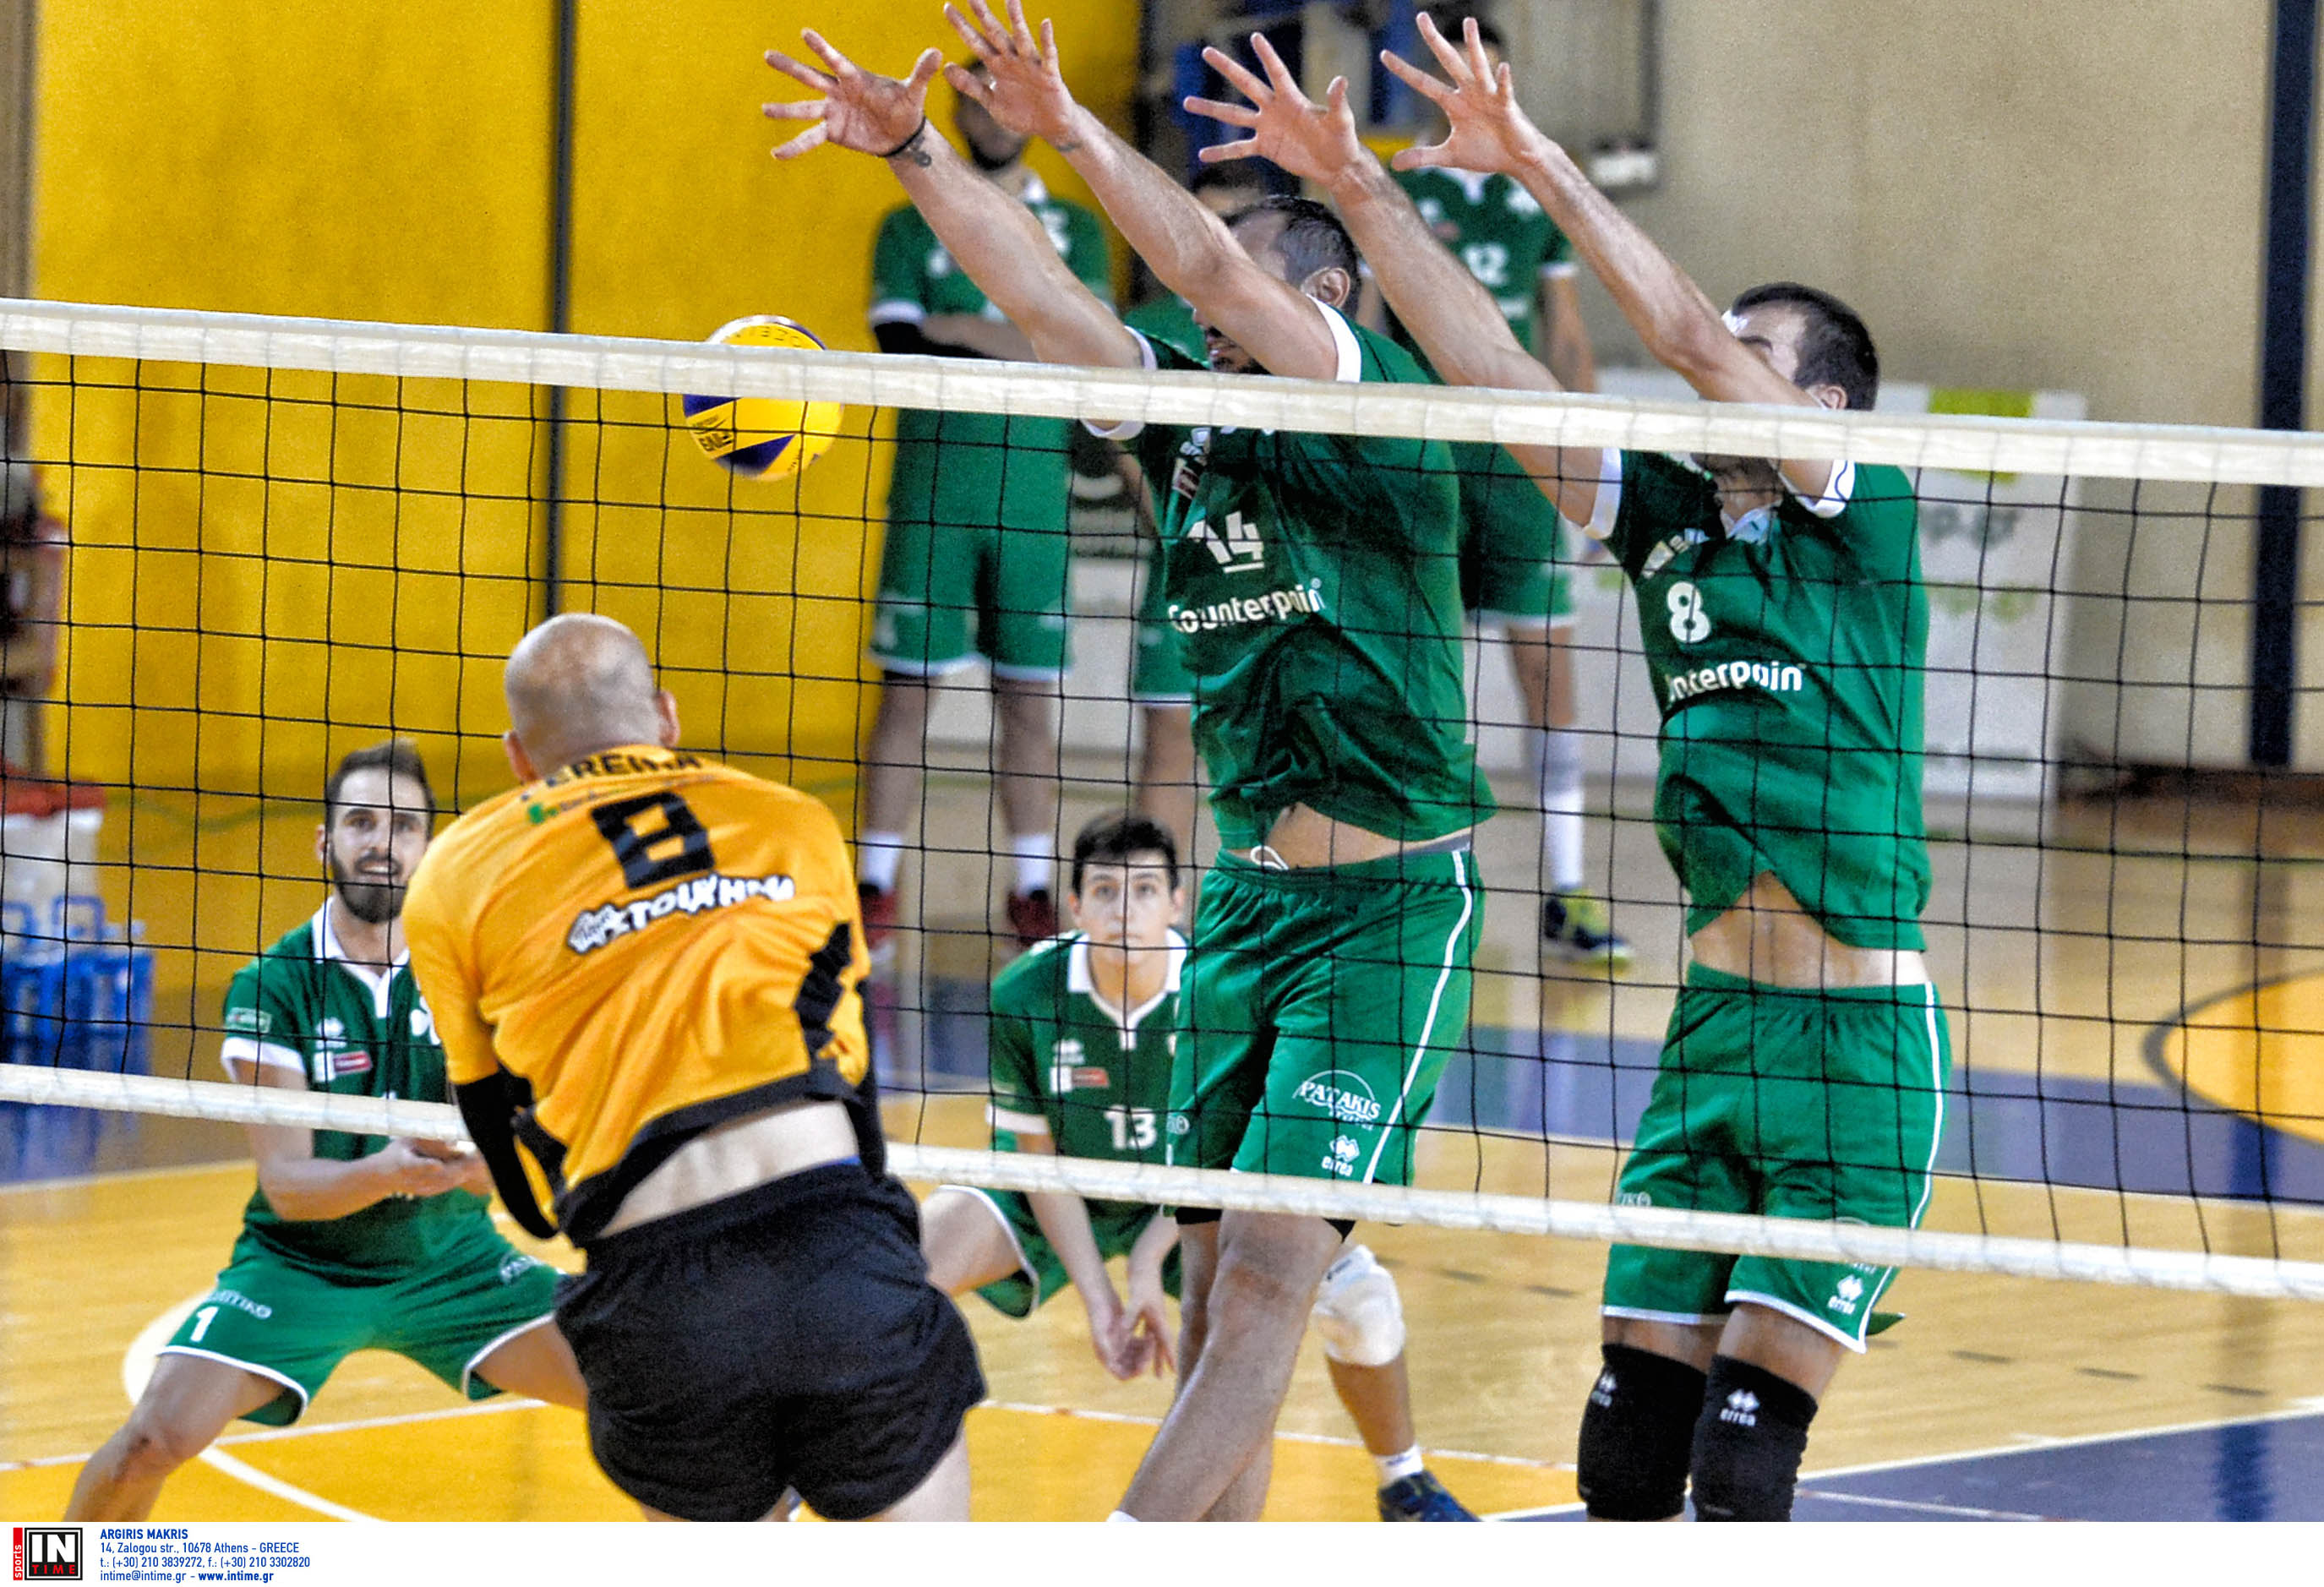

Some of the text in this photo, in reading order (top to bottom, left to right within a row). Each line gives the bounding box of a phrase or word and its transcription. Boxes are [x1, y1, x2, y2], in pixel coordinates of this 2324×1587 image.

[1187, 510, 1264, 568] 14
[1667, 581, 1711, 643] 8
[590, 791, 717, 890] 8
[1299, 1081, 1382, 1120] PATAKIS
[1105, 1104, 1158, 1149] 13
[189, 1306, 219, 1343] 1
